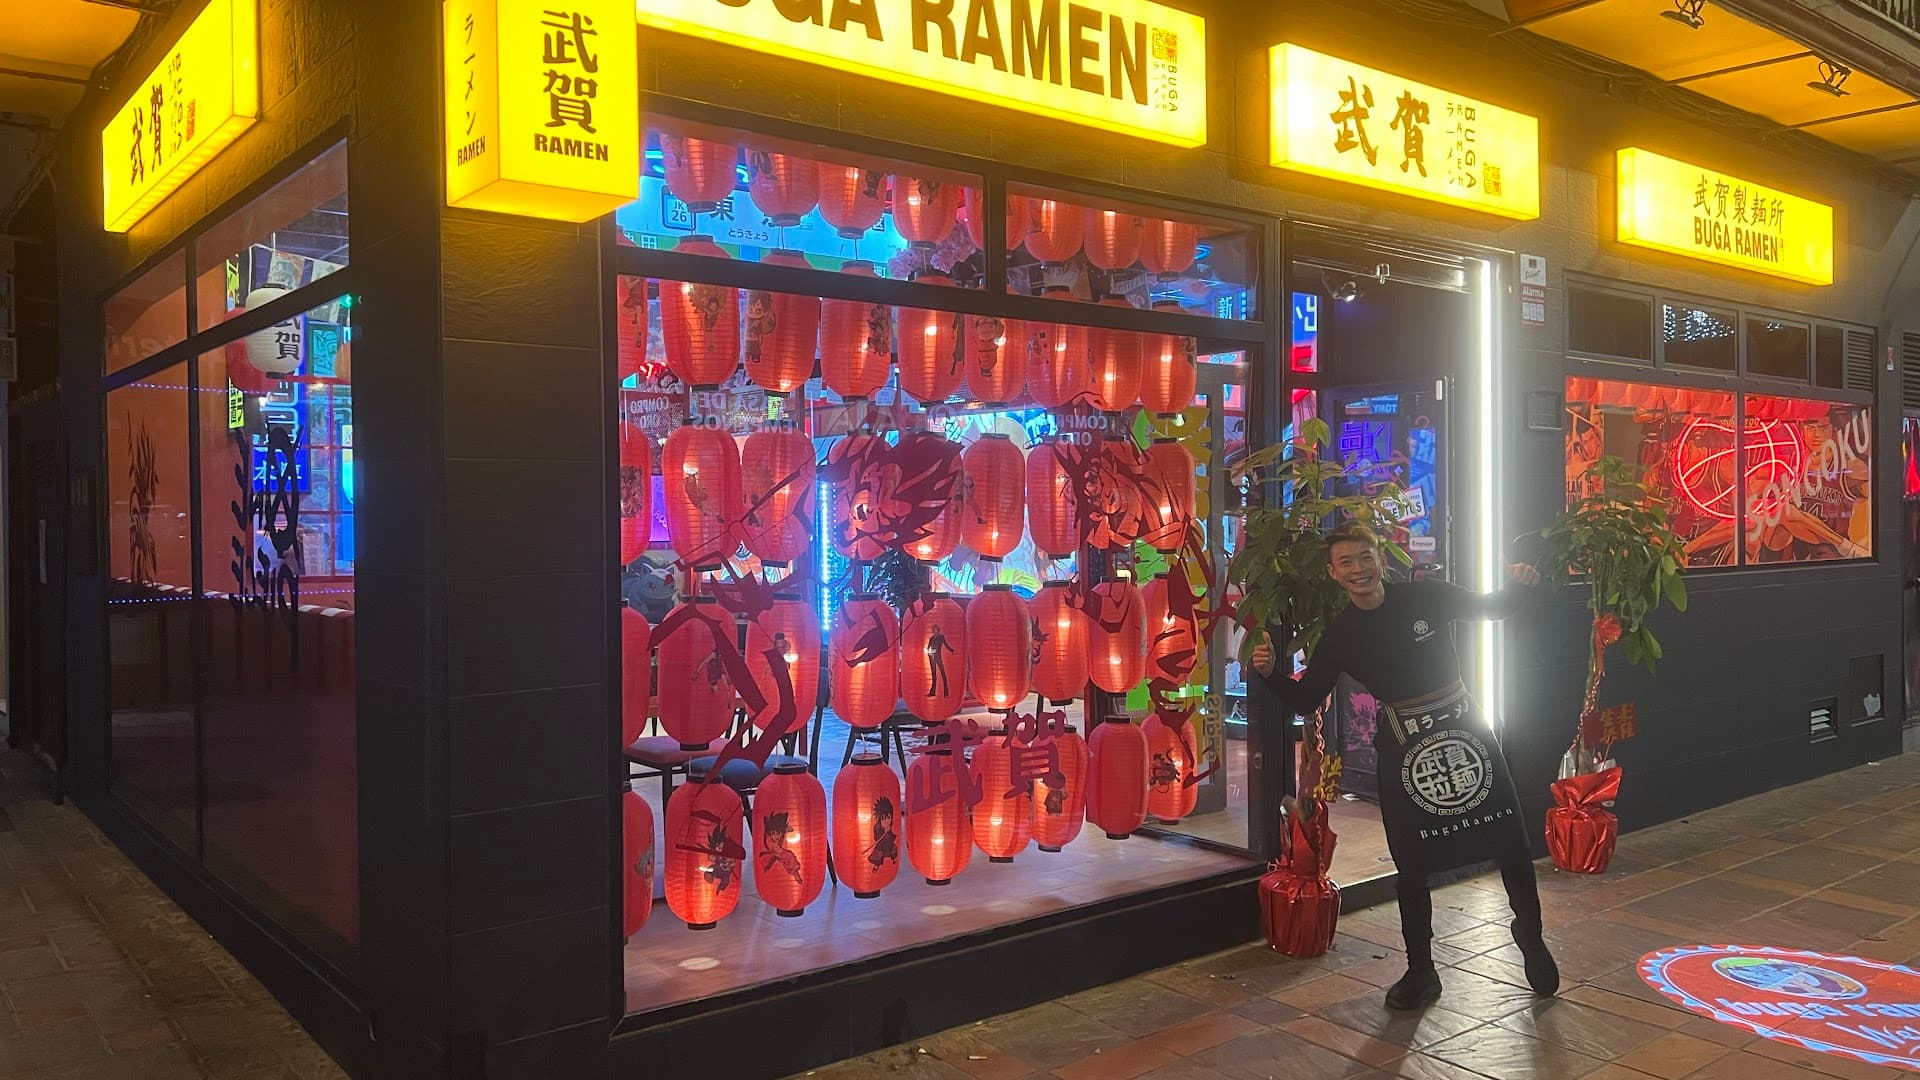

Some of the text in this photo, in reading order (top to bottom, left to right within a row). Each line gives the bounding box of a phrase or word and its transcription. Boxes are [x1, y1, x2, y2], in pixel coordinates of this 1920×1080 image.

[463, 13, 477, 136] ラーメン
[541, 10, 598, 134] 武賀
[911, 0, 1149, 106] RAMEN
[1167, 65, 1178, 112] BUGA
[130, 83, 164, 186] 武賀
[457, 135, 486, 167] RAMEN
[534, 133, 609, 162] RAMEN
[1329, 75, 1430, 178] 武賀
[1446, 102, 1455, 184] ラーメン
[1464, 106, 1477, 188] BUGA
[671, 209, 688, 222] 26
[727, 227, 770, 242] とうきょう
[1693, 215, 1731, 253] BUGA
[1735, 226, 1778, 263] RAMEN
[1803, 409, 1870, 497] GOKU
[907, 709, 1067, 815] 武賀
[1415, 742, 1471, 774] 武賀
